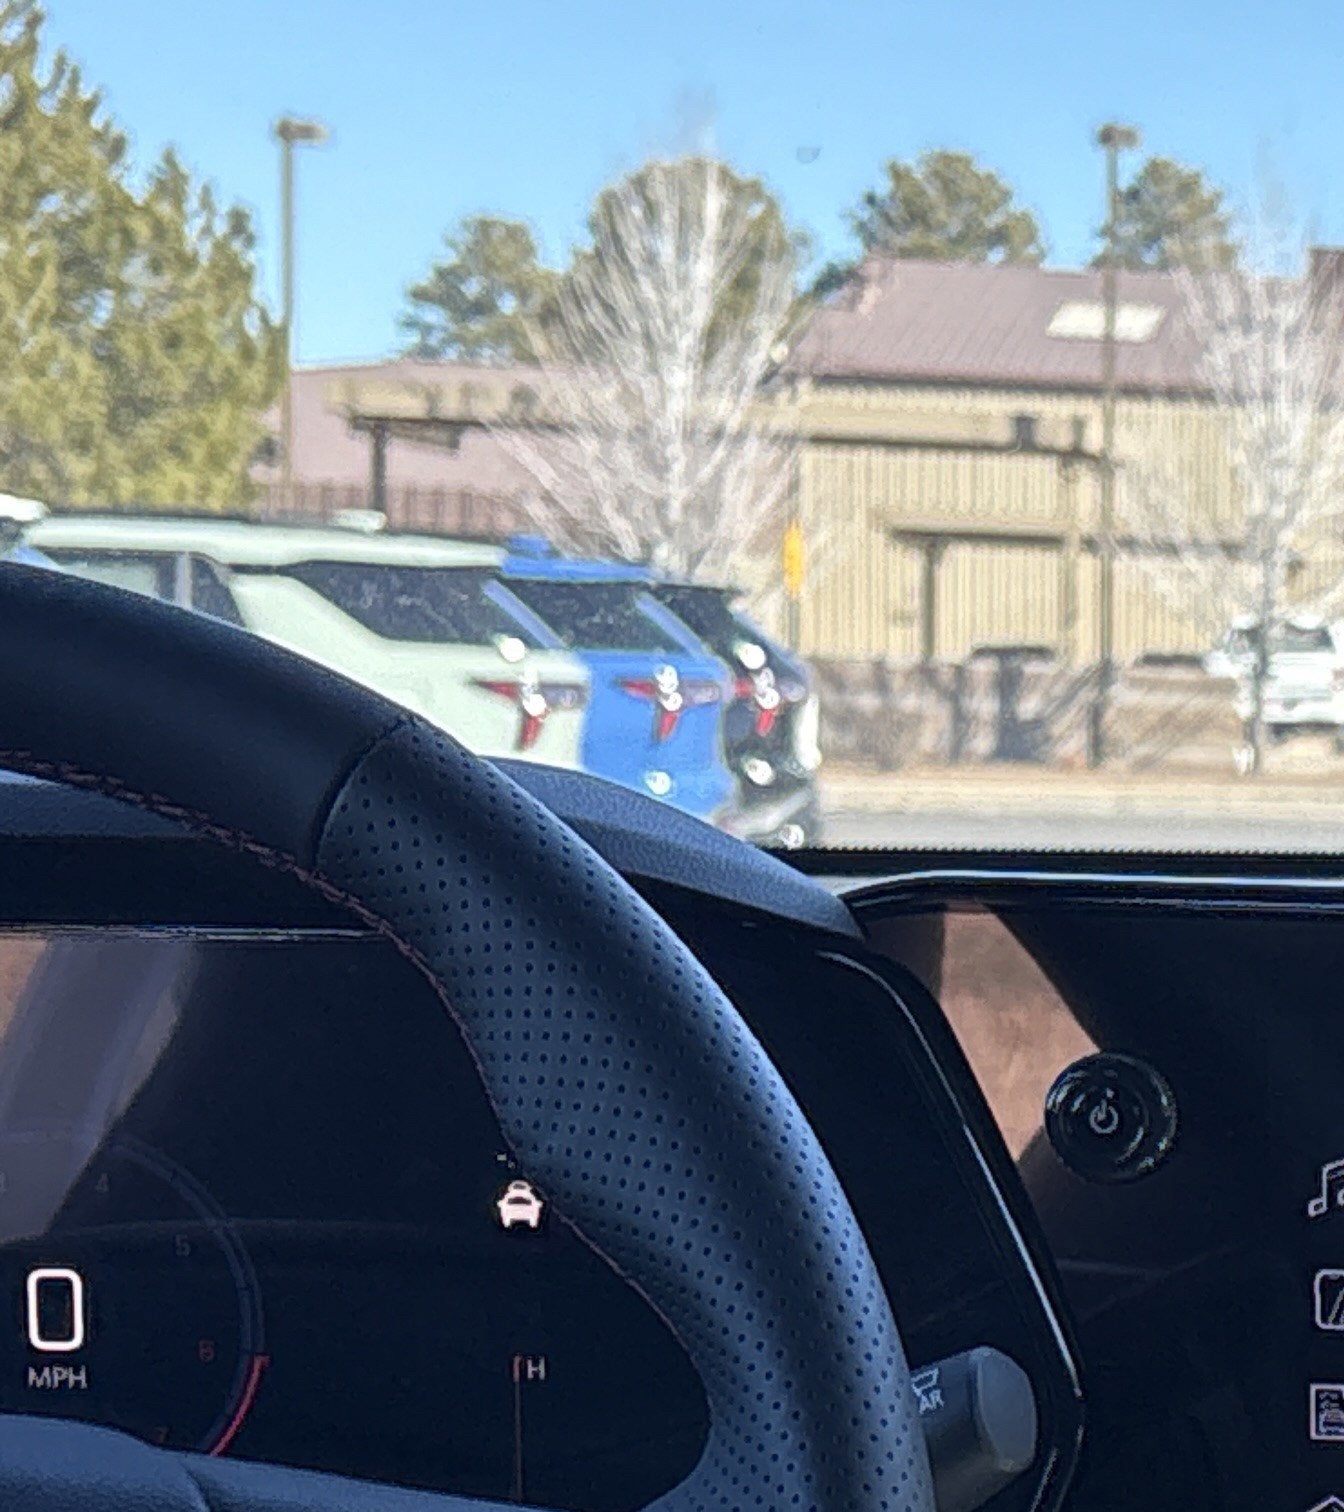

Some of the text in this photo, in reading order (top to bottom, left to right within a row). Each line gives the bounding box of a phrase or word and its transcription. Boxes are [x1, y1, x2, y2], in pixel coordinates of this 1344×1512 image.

[176, 1235, 191, 1257] 5
[26, 1267, 85, 1351] 0
[27, 1365, 88, 1389] MPH
[527, 1358, 546, 1380] H
